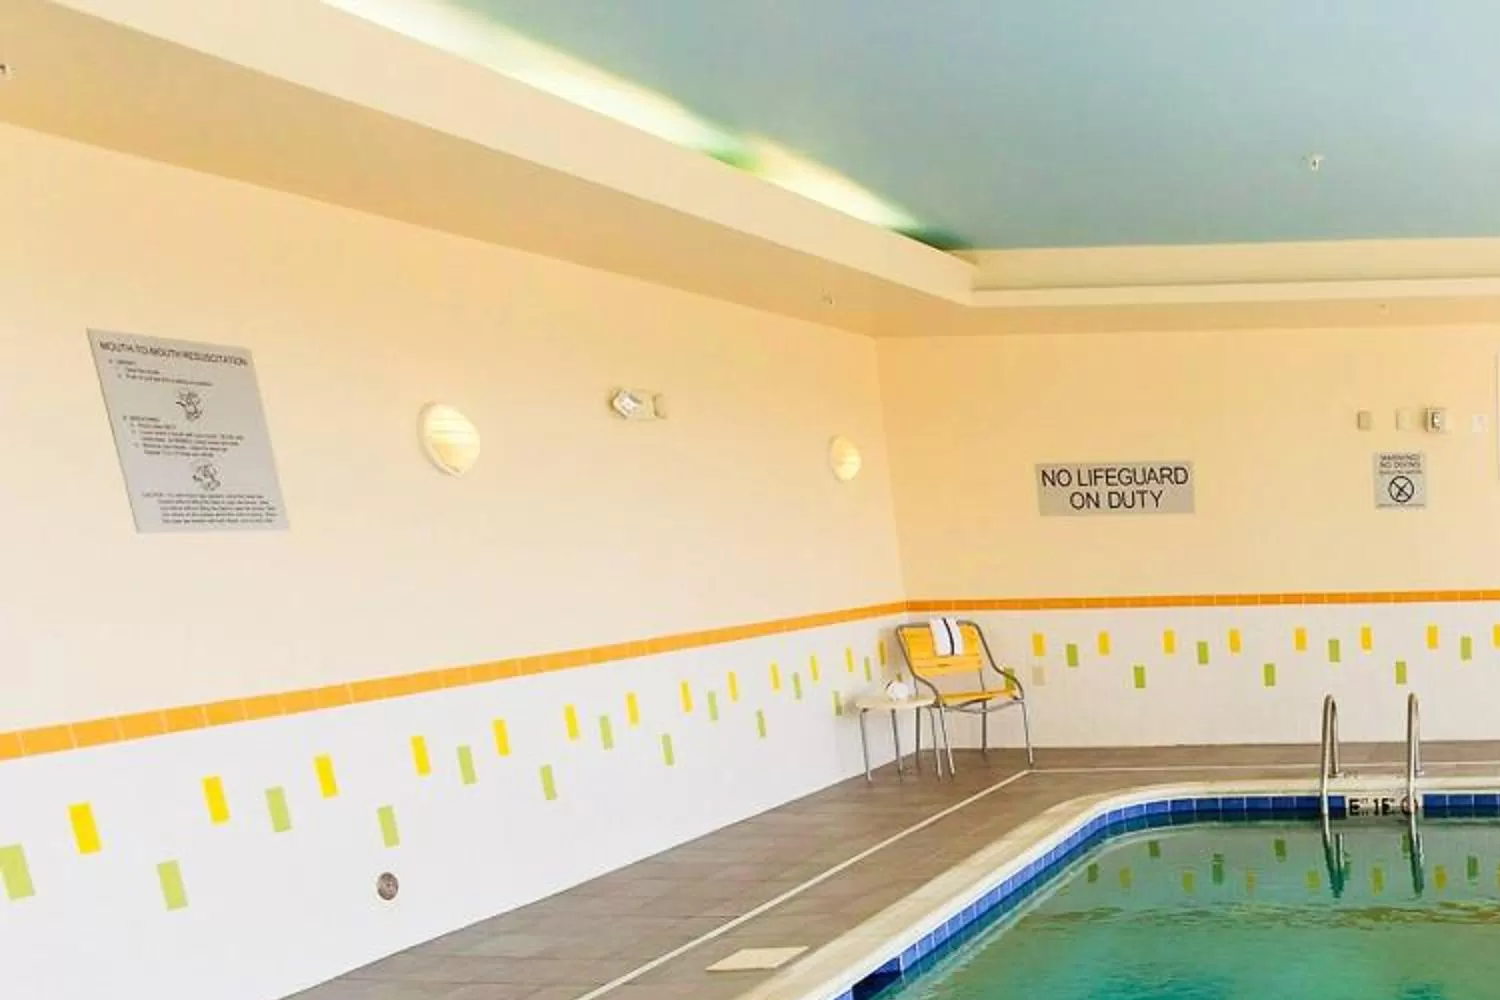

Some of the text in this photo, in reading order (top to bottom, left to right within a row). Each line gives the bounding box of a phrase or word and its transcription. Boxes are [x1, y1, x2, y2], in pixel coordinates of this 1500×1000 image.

[1041, 466, 1189, 488] NO LIFEGUARD
[1069, 490, 1163, 510] ON DUTY
